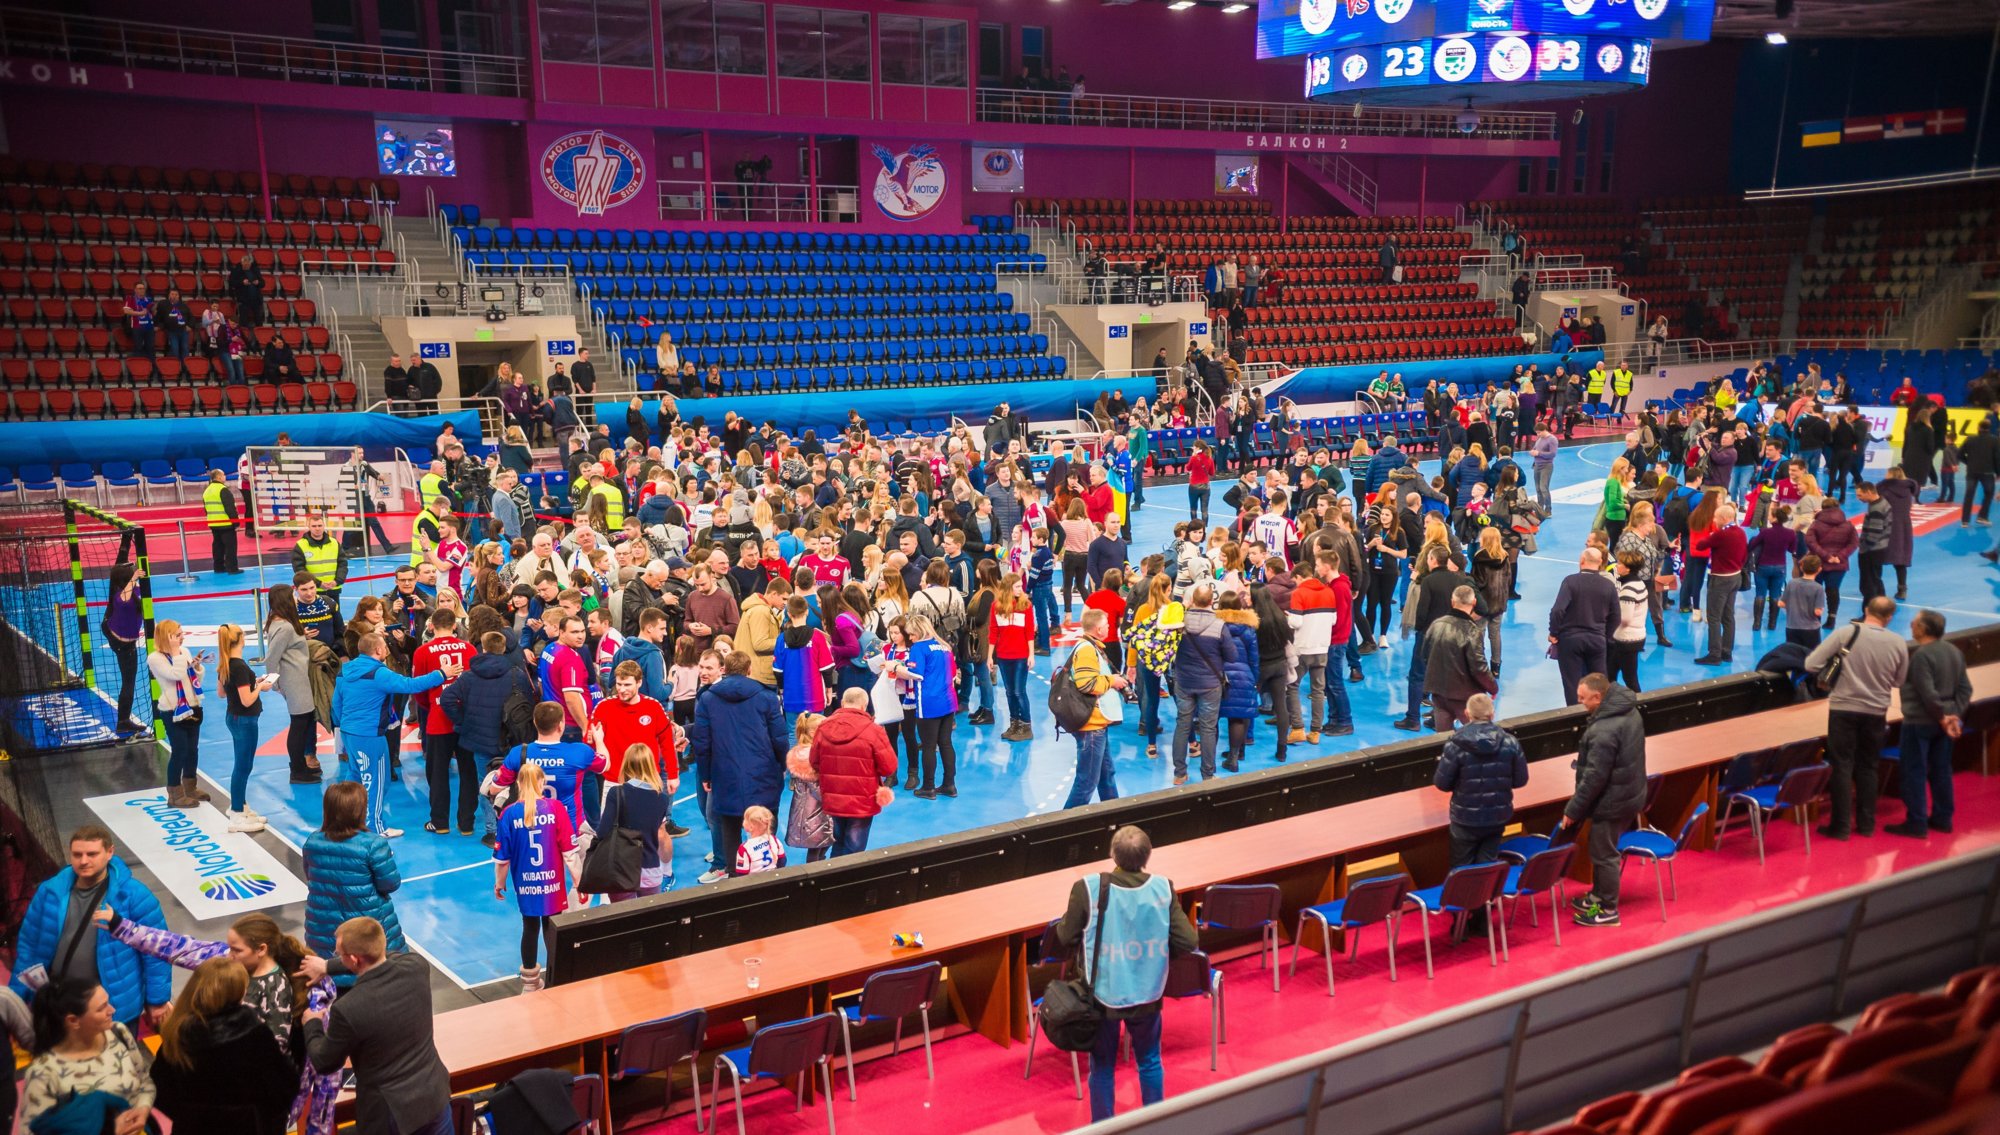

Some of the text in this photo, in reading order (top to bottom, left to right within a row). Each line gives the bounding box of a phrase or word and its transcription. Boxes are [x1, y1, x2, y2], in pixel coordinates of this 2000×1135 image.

[1384, 46, 1425, 78] 23
[1540, 40, 1581, 71] 33
[124, 72, 134, 89] 1
[548, 136, 583, 161] МОТОР
[1247, 135, 1347, 149] БАЛКОН 2
[547, 175, 639, 200] MOTOR SICH
[913, 185, 939, 194] MOTOR
[439, 344, 446, 352] 2
[1265, 528, 1275, 549] 14
[428, 642, 467, 653] MOTOR
[526, 758, 565, 767] MOTOR
[513, 813, 555, 829] MTOR
[529, 829, 544, 867] 5
[189, 842, 244, 877] Nord
[762, 850, 772, 868] 5
[522, 870, 556, 881] KUBATKO
[519, 882, 561, 895] MOTOR-BANK
